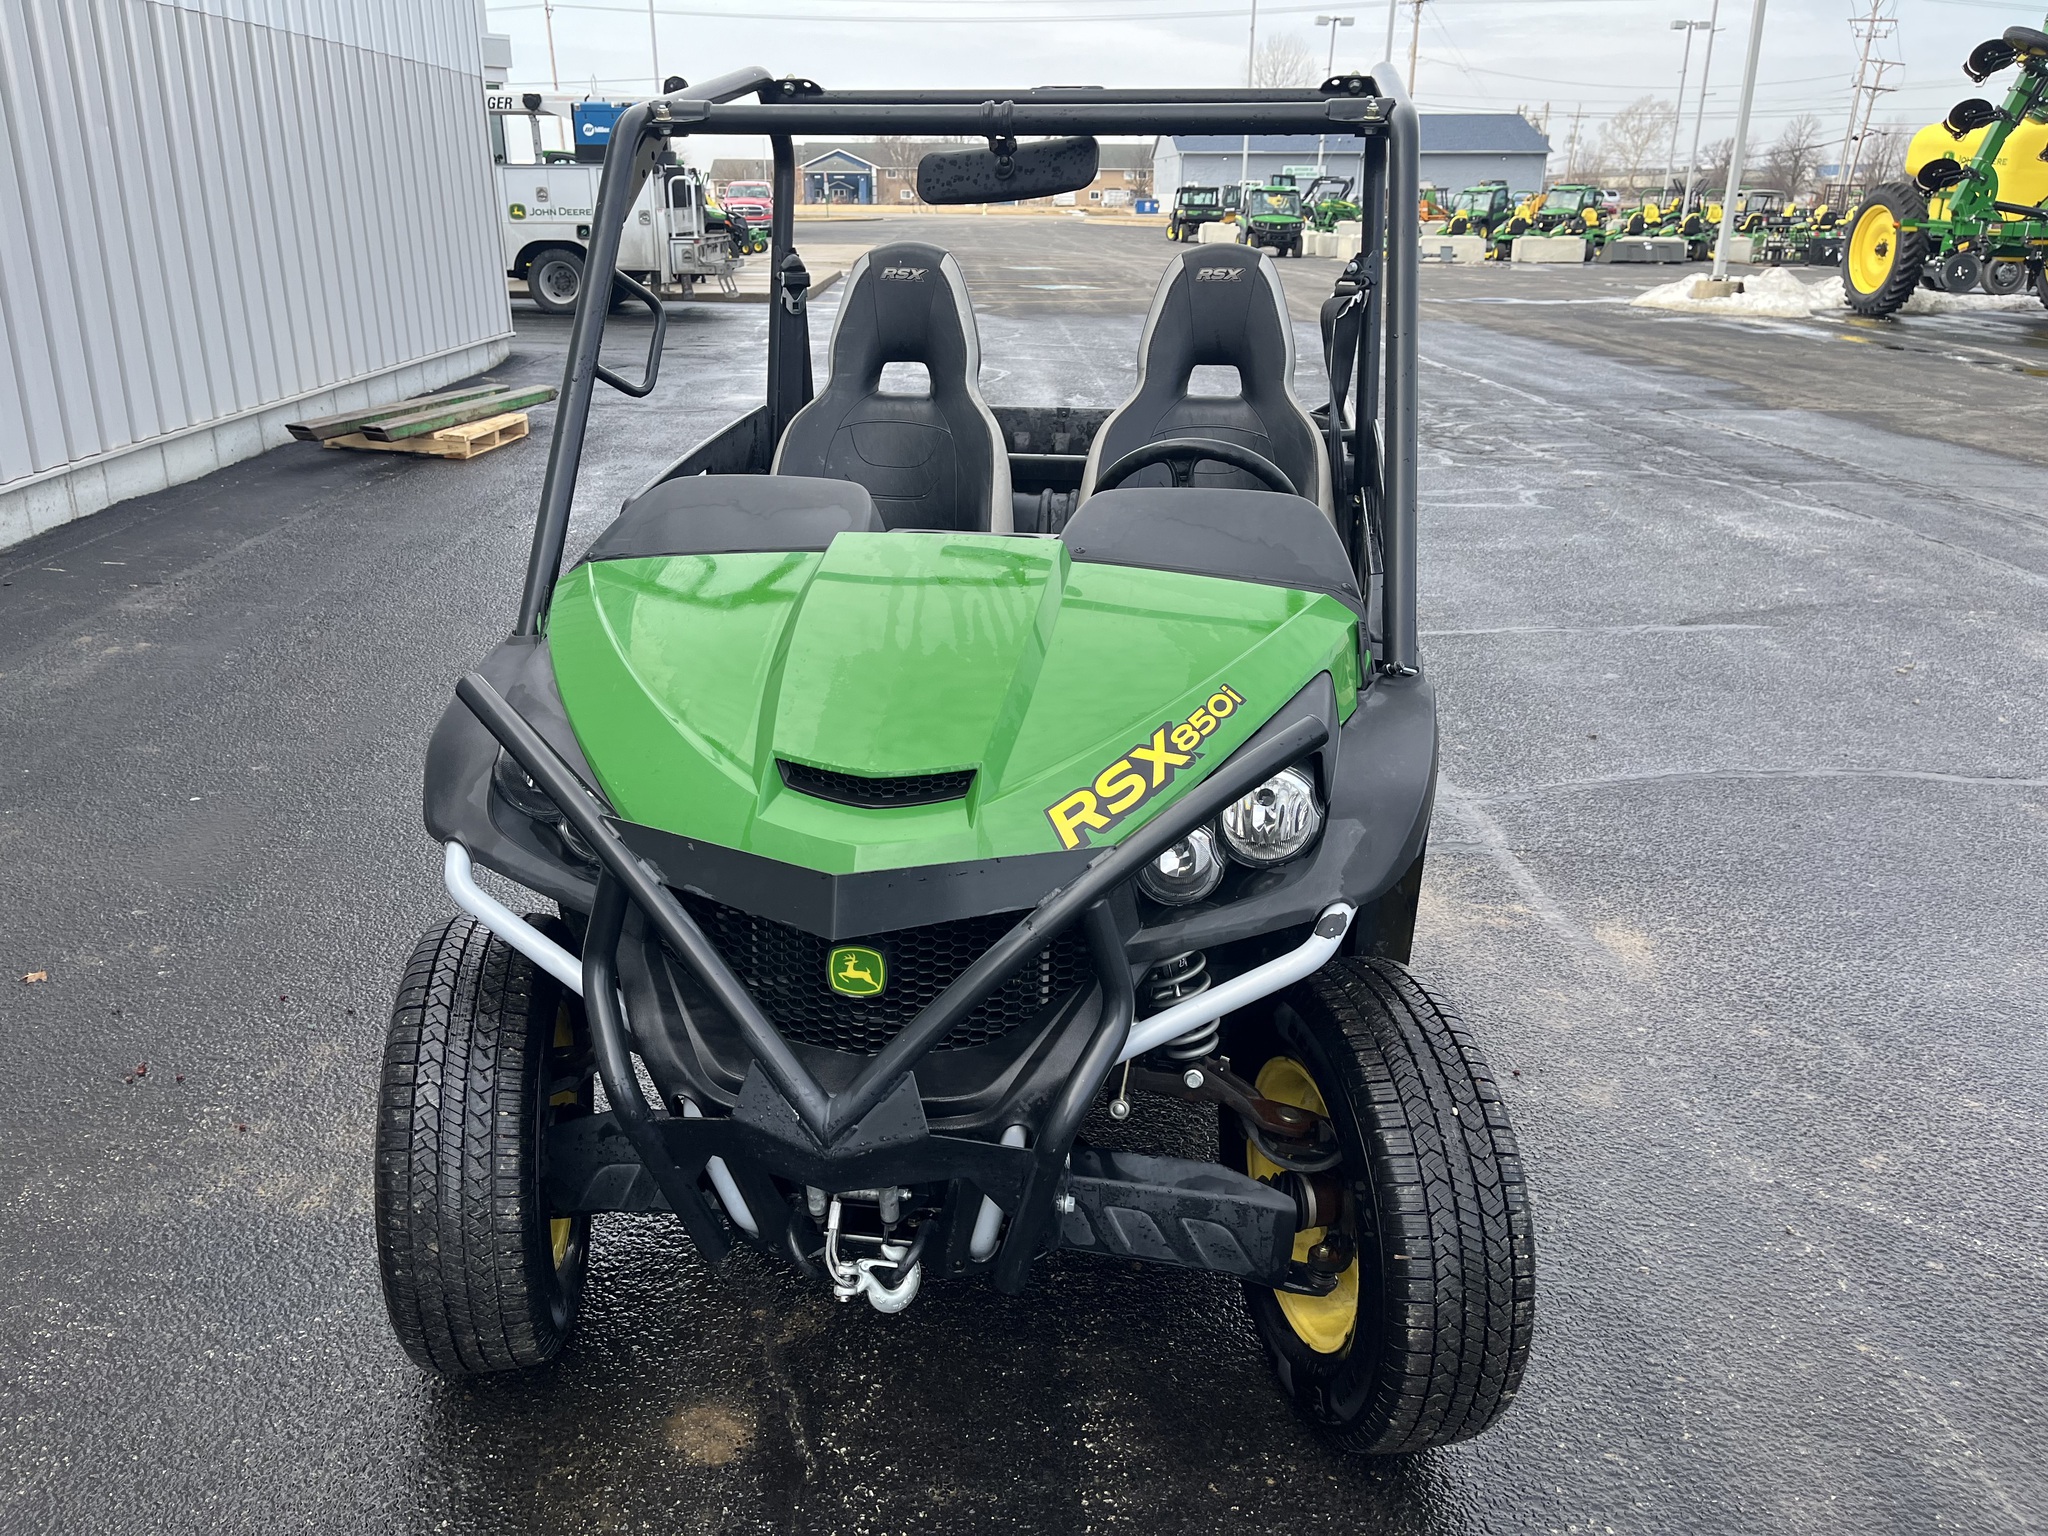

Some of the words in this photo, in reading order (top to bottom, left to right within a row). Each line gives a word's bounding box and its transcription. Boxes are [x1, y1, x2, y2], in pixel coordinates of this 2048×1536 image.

[488, 96, 513, 110] GER
[529, 207, 557, 217] JOHN
[558, 206, 593, 216] DEERE
[880, 266, 930, 282] RSX
[1195, 266, 1246, 282] RSX
